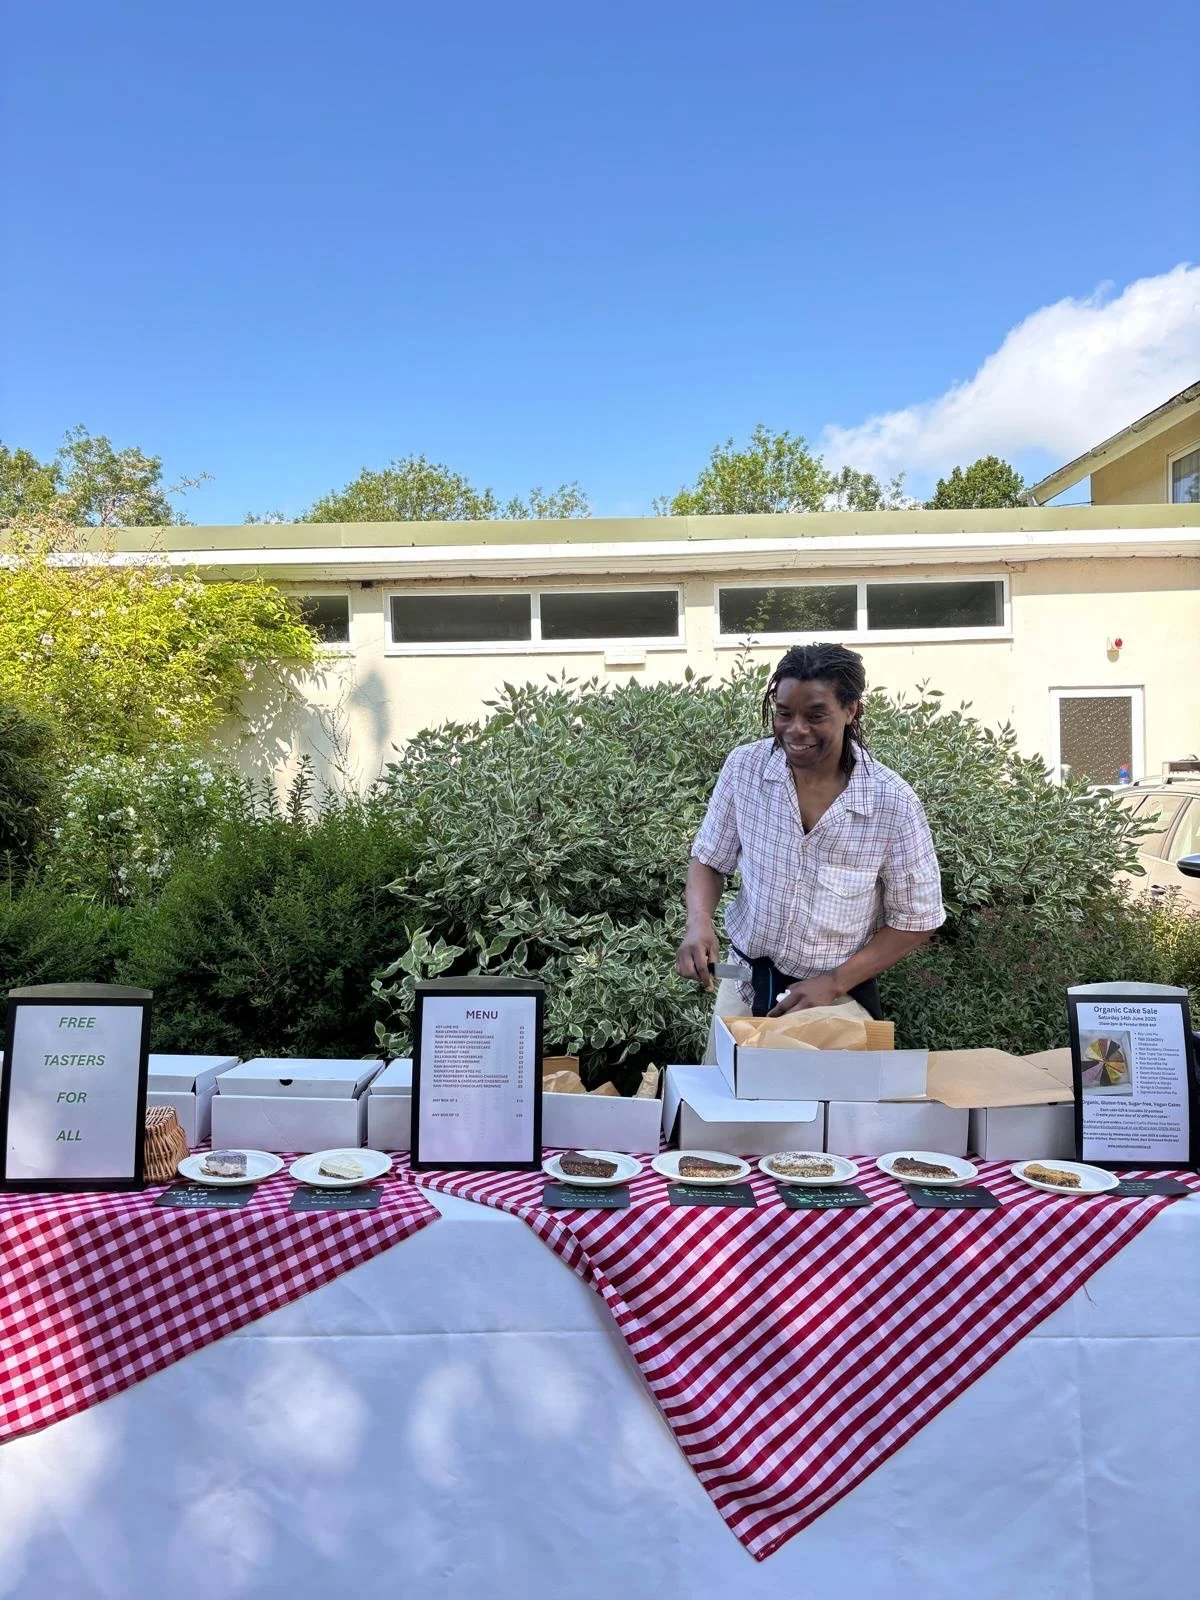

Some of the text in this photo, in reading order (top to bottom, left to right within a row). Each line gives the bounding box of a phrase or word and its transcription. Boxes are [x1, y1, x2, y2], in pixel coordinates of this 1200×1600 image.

[466, 1010, 498, 1020] MENU
[1094, 1006, 1158, 1014] Organic Cake Sale
[58, 1017, 96, 1028] FREE
[44, 1055, 105, 1066] TASTERS
[56, 1092, 87, 1103] FOR
[56, 1130, 82, 1140] ALL
